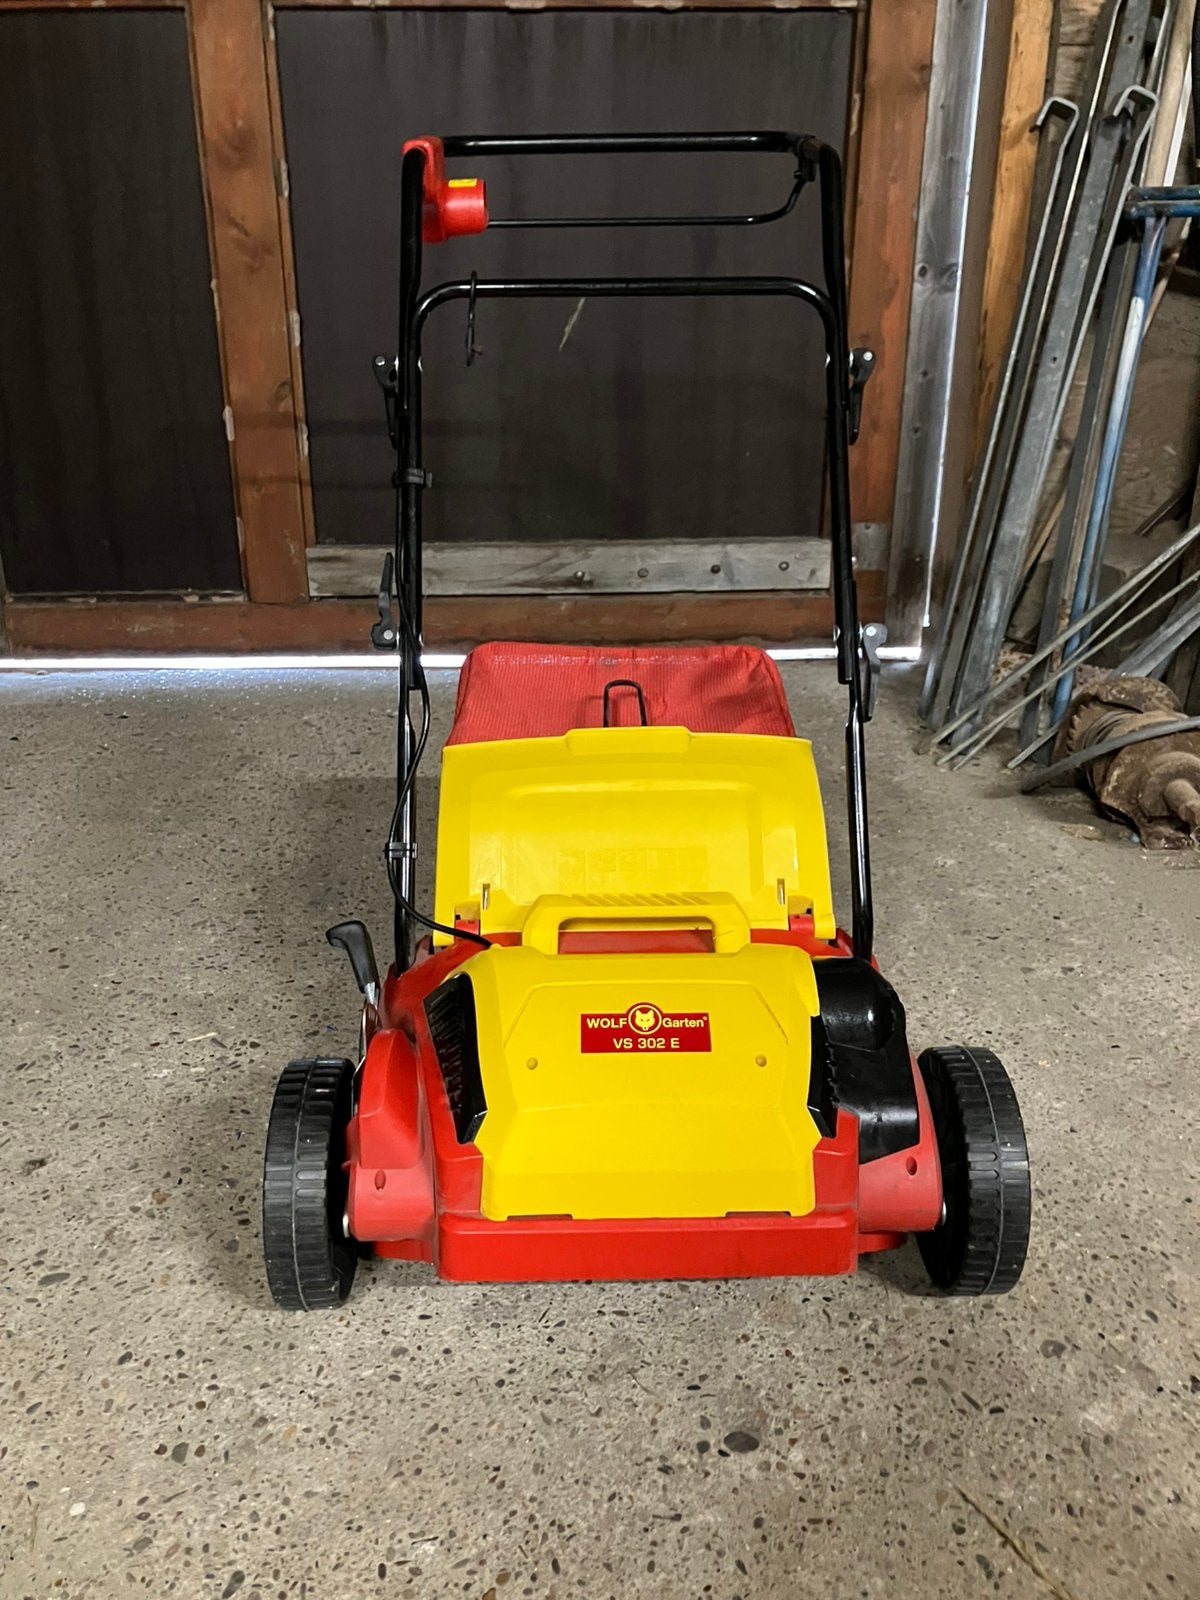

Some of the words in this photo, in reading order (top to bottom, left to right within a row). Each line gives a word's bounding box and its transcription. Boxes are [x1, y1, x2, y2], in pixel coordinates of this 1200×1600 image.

[586, 1017, 628, 1029] WOLF
[613, 1038, 633, 1049] VS
[637, 1038, 666, 1049] 302
[670, 1038, 680, 1049] E
